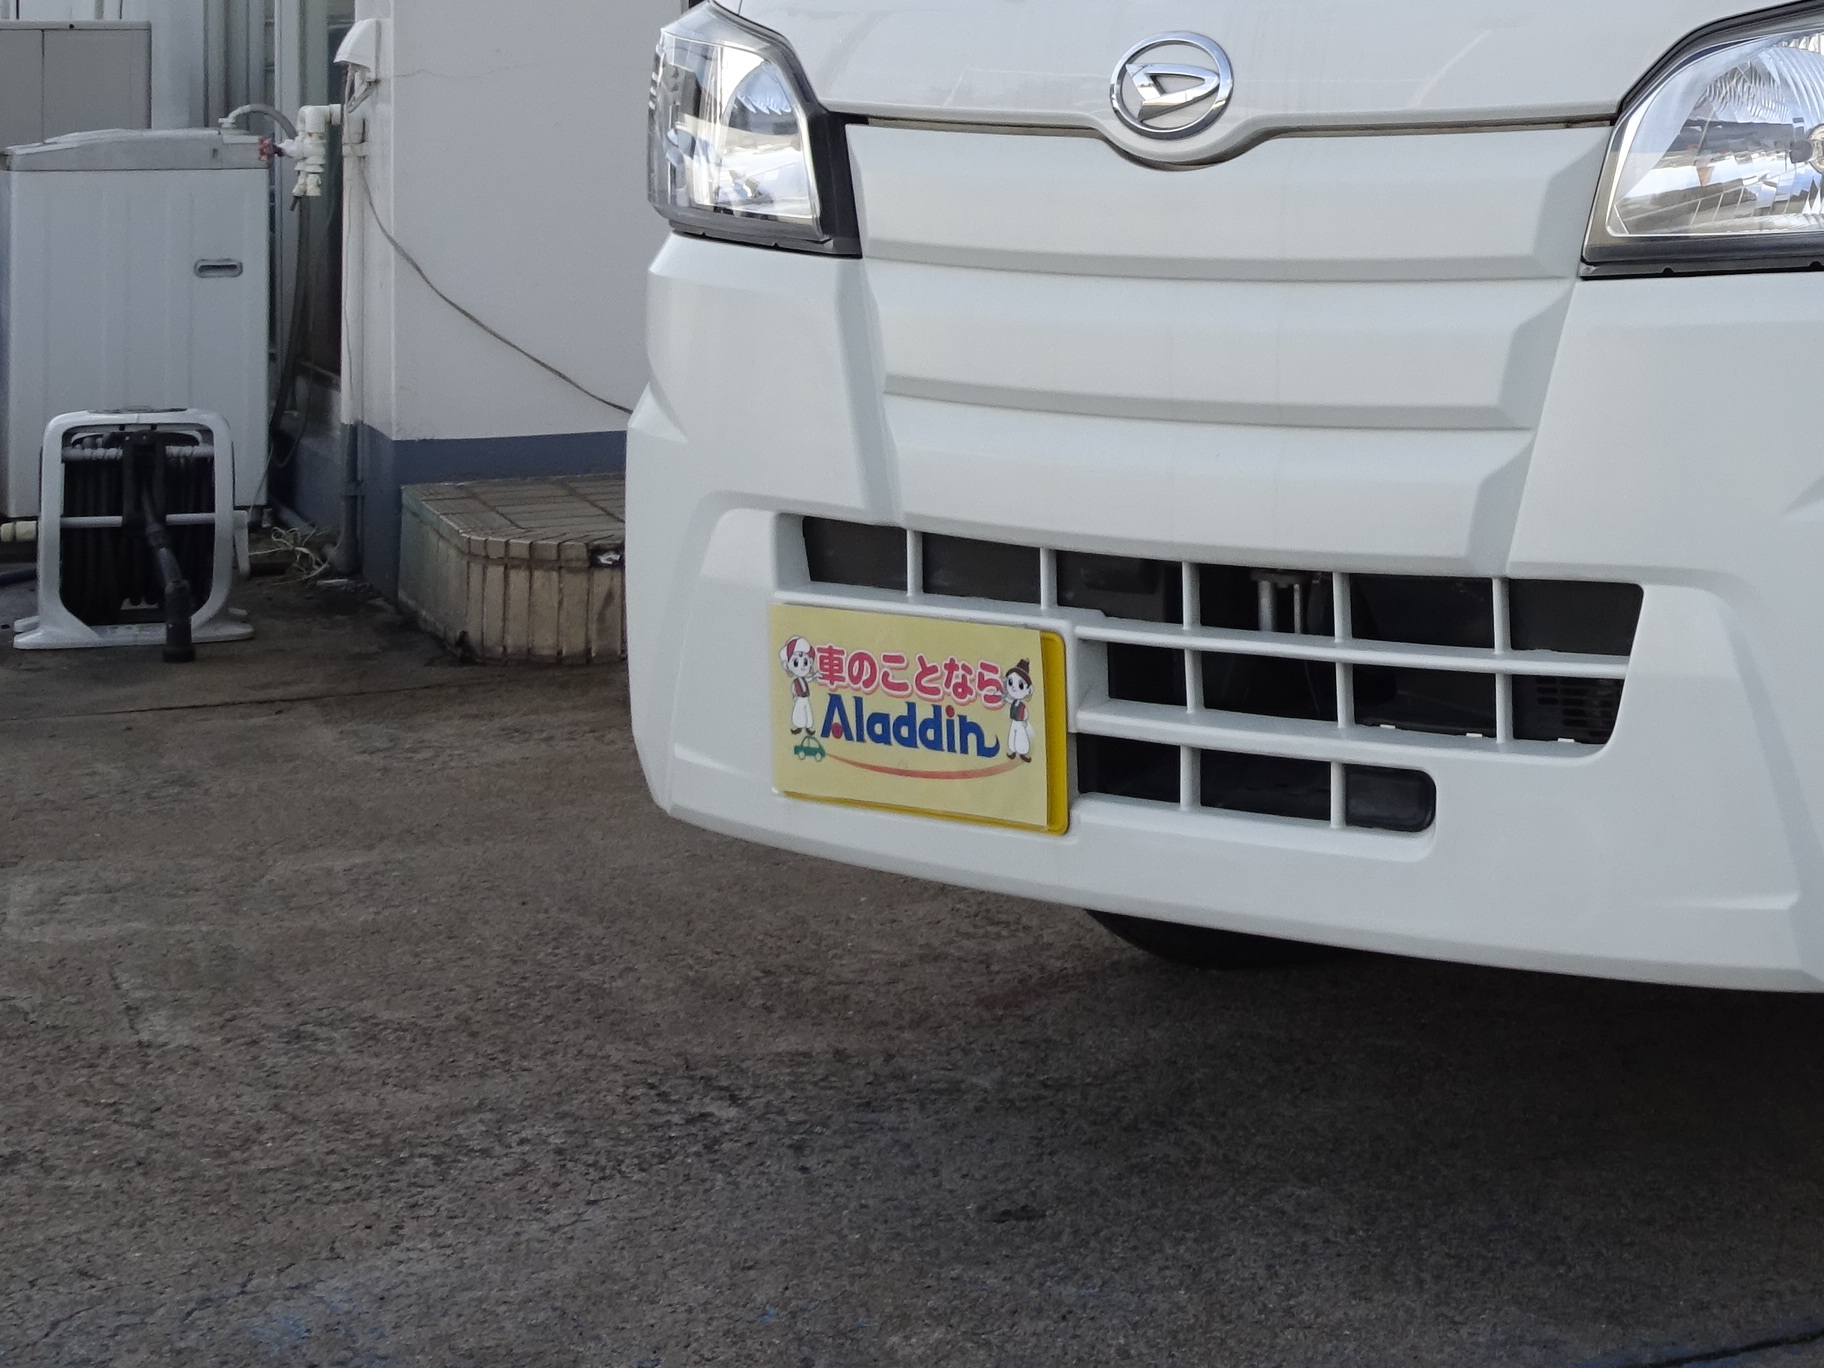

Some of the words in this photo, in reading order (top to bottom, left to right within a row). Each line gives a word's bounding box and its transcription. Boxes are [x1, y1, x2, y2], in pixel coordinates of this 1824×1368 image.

[816, 645, 1005, 709] 車のことなら
[820, 692, 1000, 759] Aladdin
